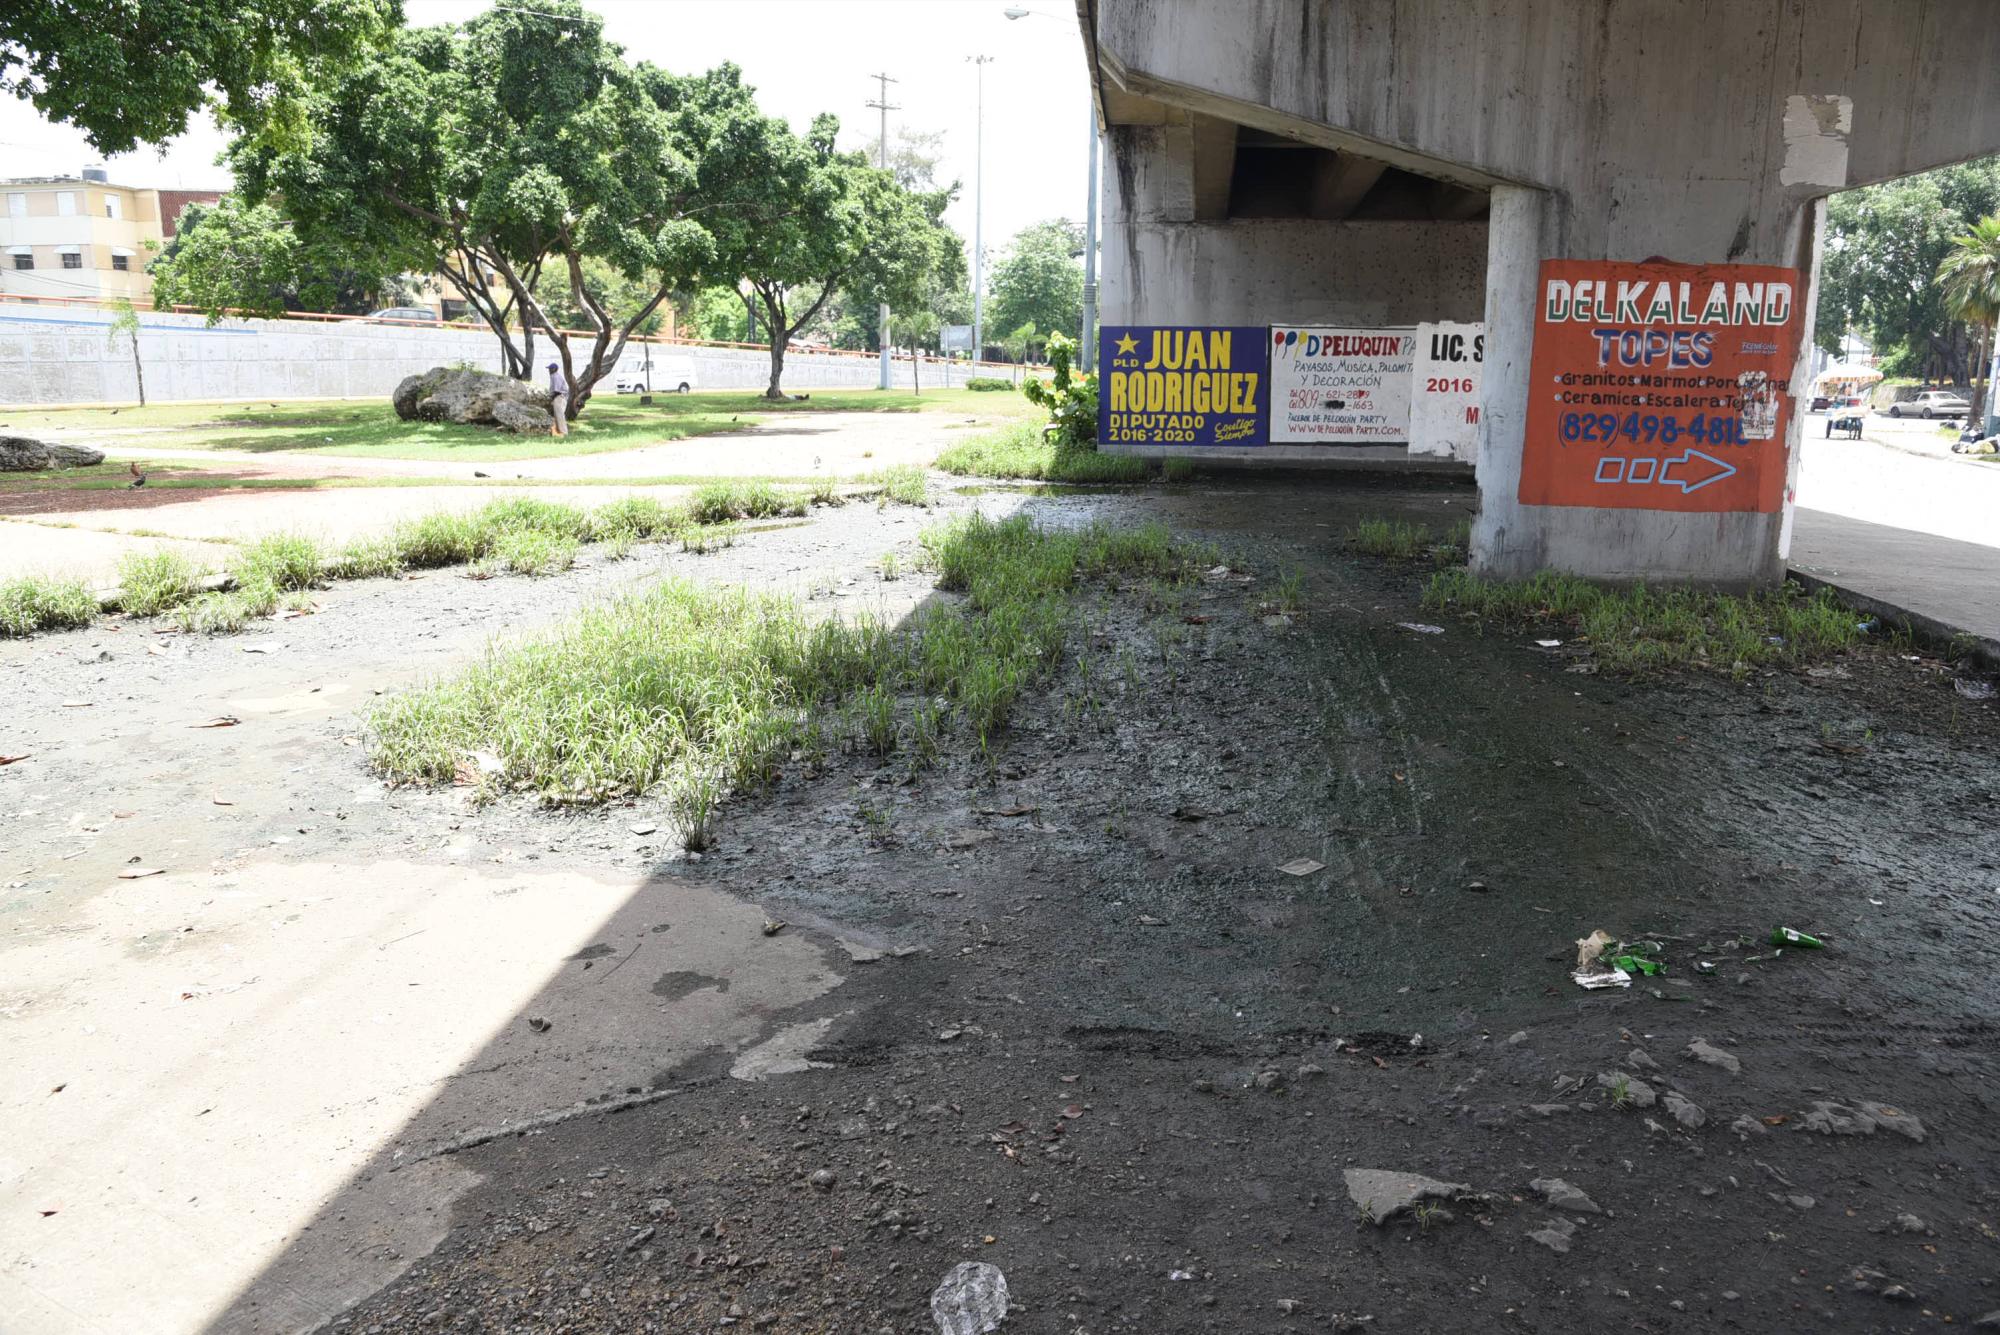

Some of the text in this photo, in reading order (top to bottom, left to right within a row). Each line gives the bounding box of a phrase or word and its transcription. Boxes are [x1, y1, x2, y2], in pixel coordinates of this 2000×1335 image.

[1545, 279, 1793, 327] DELKALAND
[1144, 330, 1232, 369] JUAN
[1430, 333, 1468, 362] LIC.
[1591, 328, 1715, 369] TOPES
[1113, 359, 1139, 367] PLD
[1301, 374, 1309, 387] Y
[1426, 378, 1473, 393] 2016
[1562, 371, 1636, 387] Granitos
[1110, 371, 1258, 413] RODRIGUEZ
[1562, 390, 1640, 405] Ceramica
[1646, 393, 1720, 408] Escalera
[1110, 414, 1205, 429] DIPUTADO
[1359, 415, 1388, 424] PARTY
[1465, 406, 1479, 425] M
[1109, 429, 1195, 441] 2016-2020
